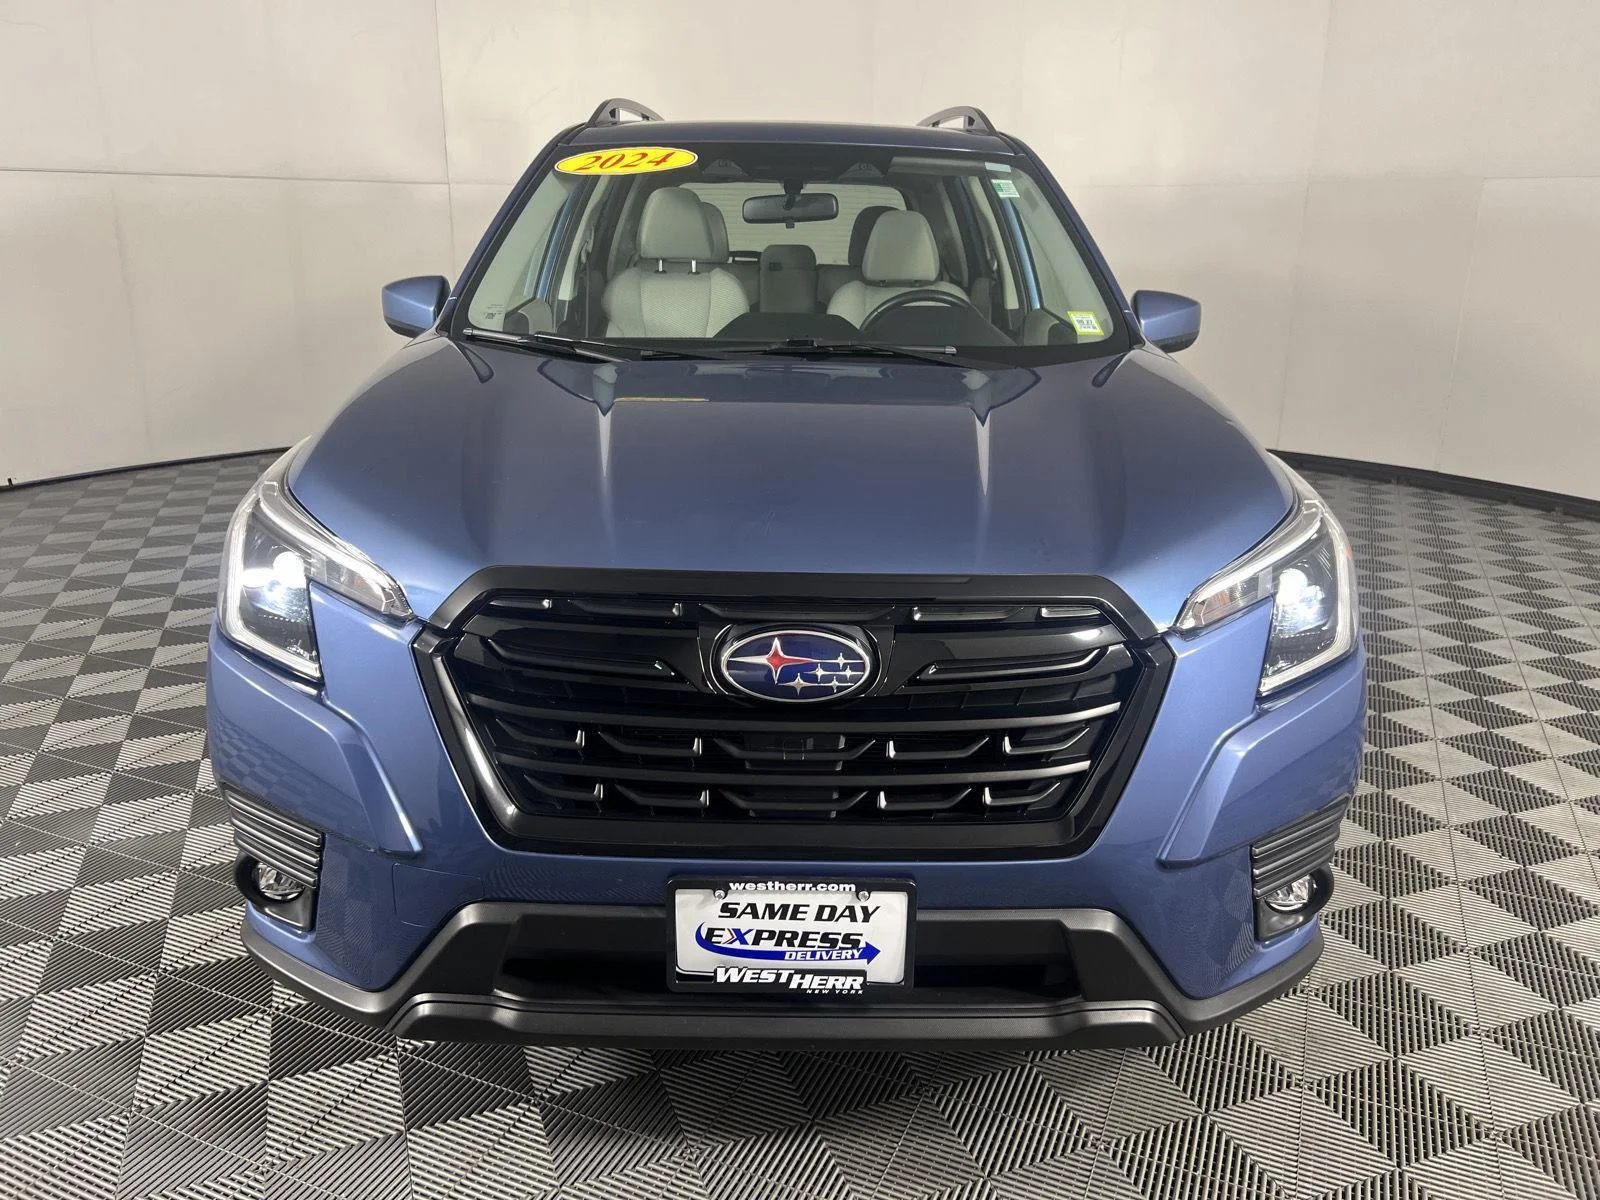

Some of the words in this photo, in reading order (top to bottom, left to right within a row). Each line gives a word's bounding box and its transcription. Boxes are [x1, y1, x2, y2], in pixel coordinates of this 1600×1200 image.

[574, 151, 676, 171] 2024
[729, 881, 856, 892] westherr.com
[718, 902, 810, 921] SAME
[814, 905, 880, 923] DAY
[704, 927, 865, 950] EXPRESS
[784, 948, 863, 961] DELIVERY
